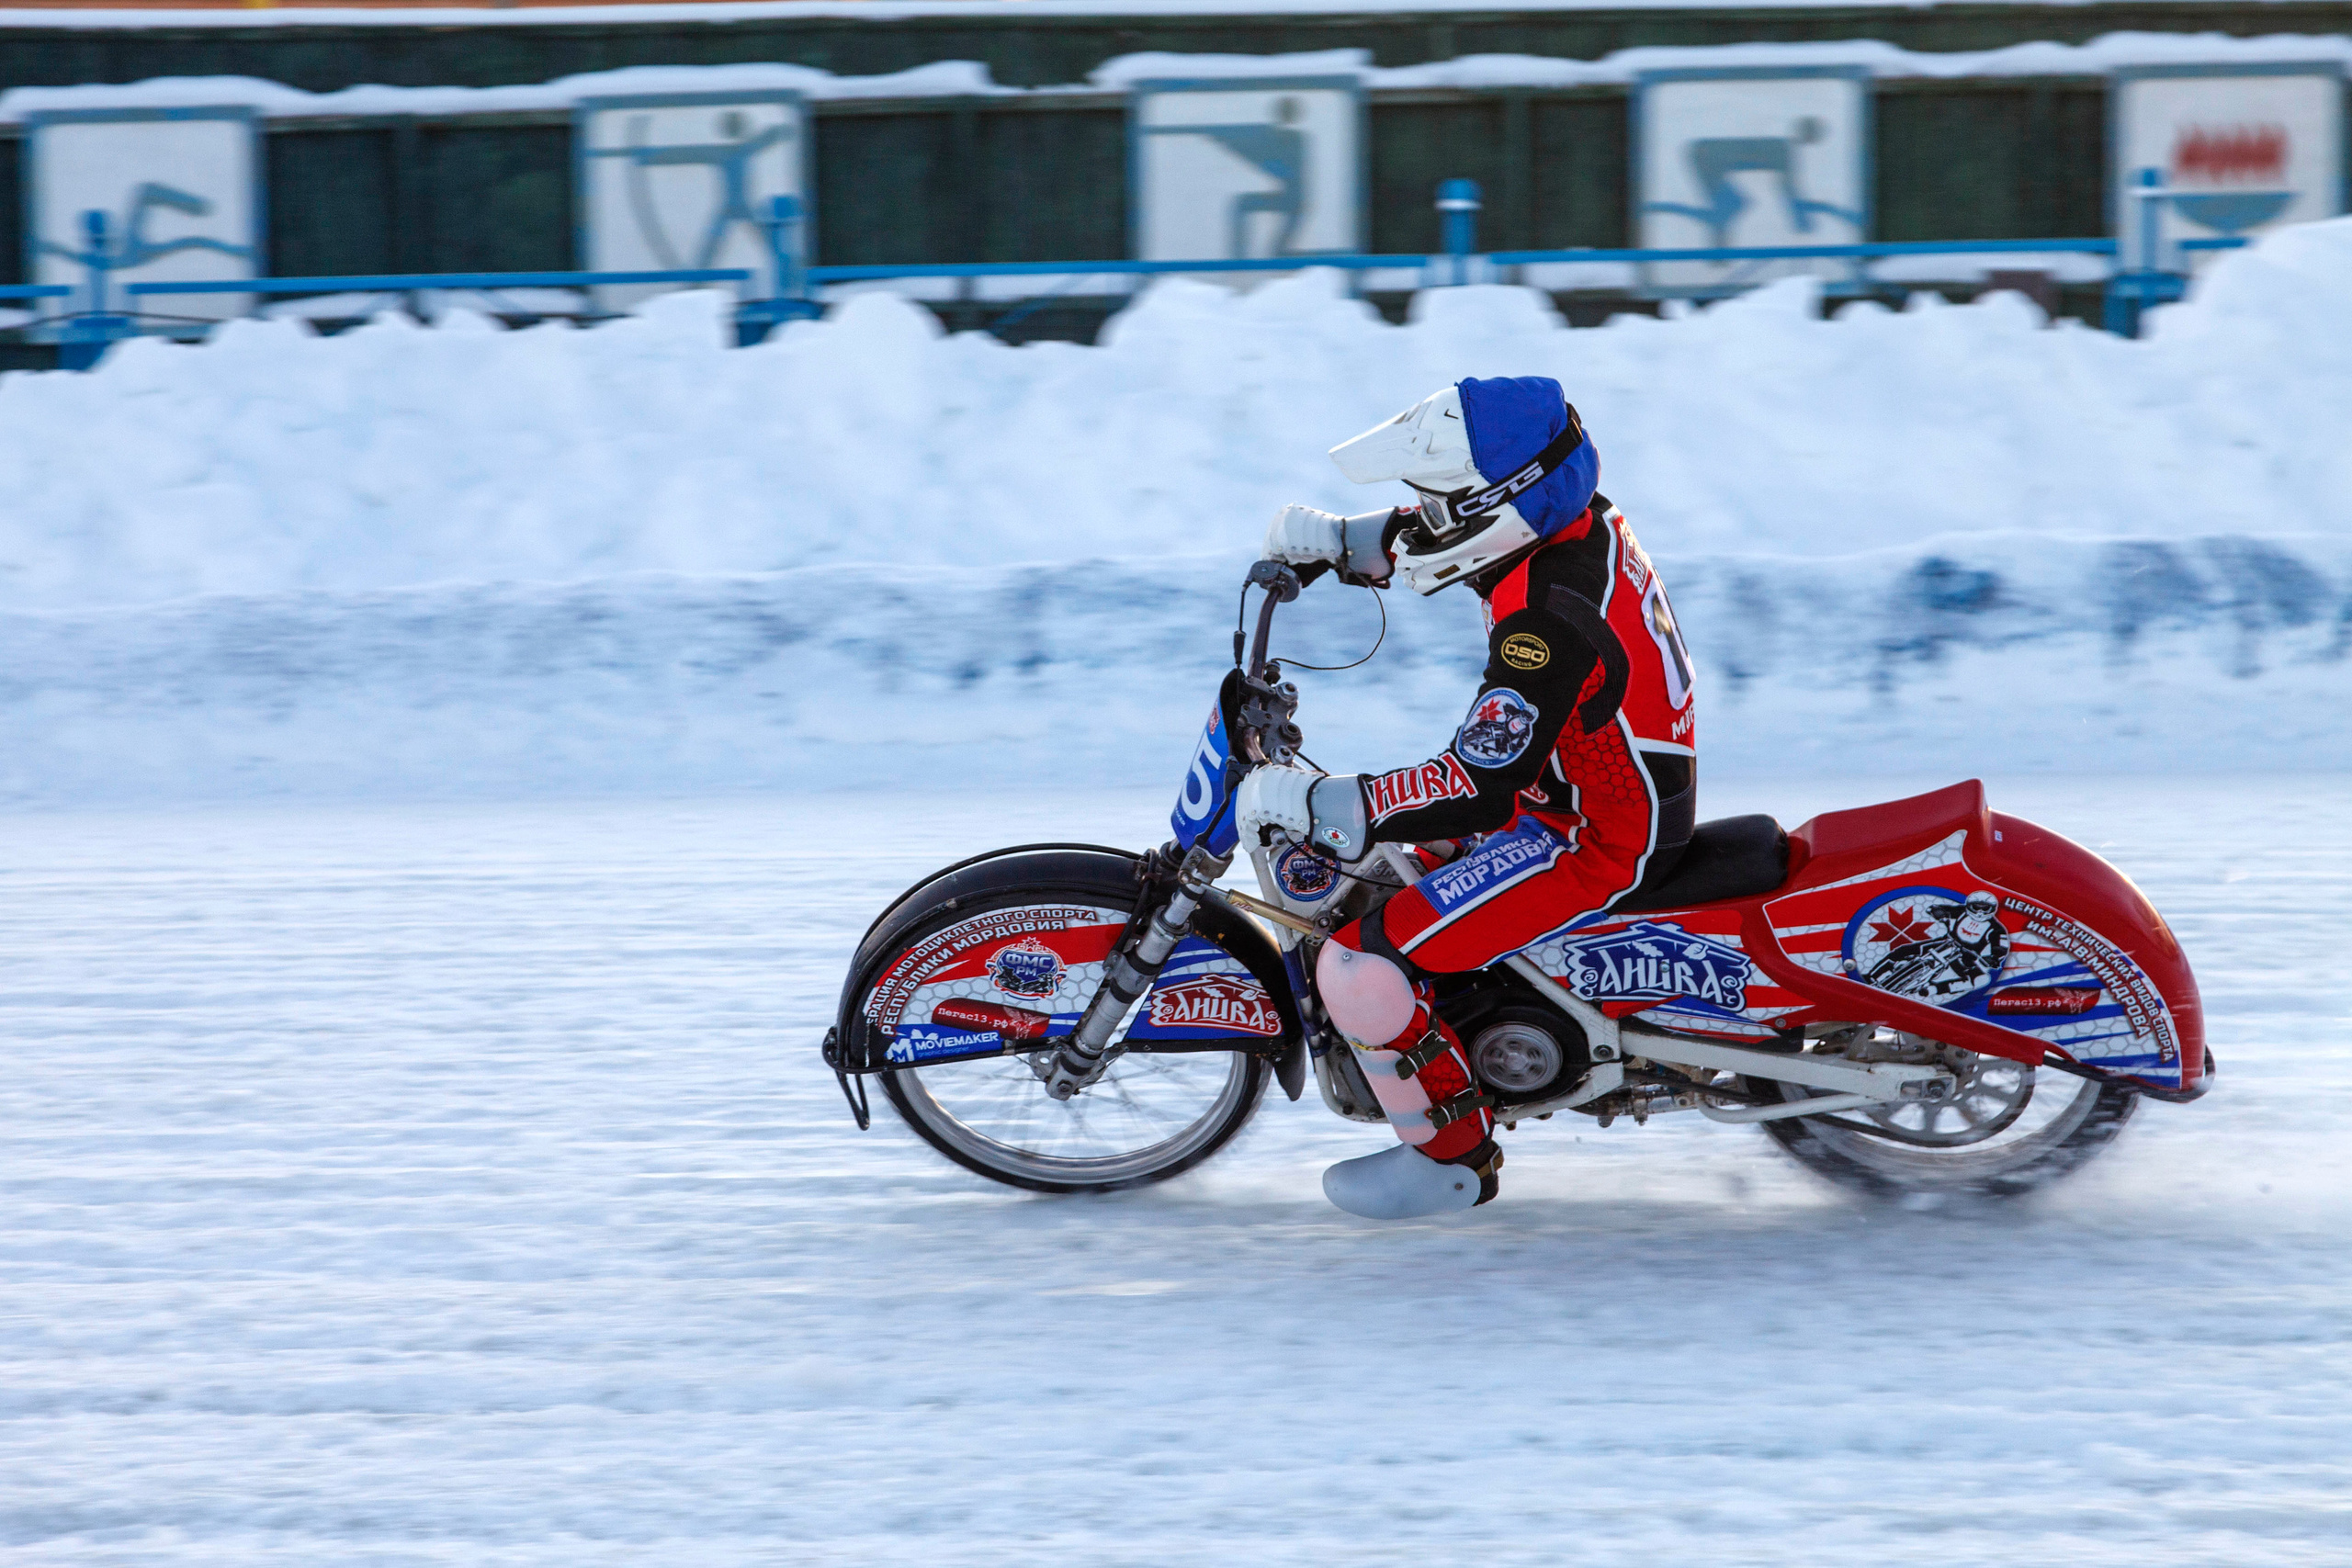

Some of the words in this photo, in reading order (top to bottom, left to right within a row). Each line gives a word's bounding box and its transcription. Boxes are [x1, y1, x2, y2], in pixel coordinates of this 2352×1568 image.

[1181, 731, 1223, 821] 5
[2027, 920, 2054, 940] ИМ.
[892, 910, 1027, 977] МОТОЦИКЛЕТНОГО
[1029, 908, 1097, 921] СПОРТА
[1006, 953, 1052, 969] ФМС
[1016, 965, 1037, 976] РМ
[881, 946, 955, 1035] РЕСПУБЛИКИ
[952, 919, 1065, 953] МОРДОВИЯ
[2005, 897, 2053, 920] ЦЕНТР
[2055, 917, 2135, 980] ТЕХНИЧЕСКИХ
[2130, 976, 2159, 1017] ВИДОВ
[2153, 1016, 2175, 1062] СПОРТА
[1993, 998, 2063, 1009] Пегас13.рф
[938, 1008, 1009, 1029] Пегас13.рф
[914, 1032, 1000, 1051] MOVIEMAKER
